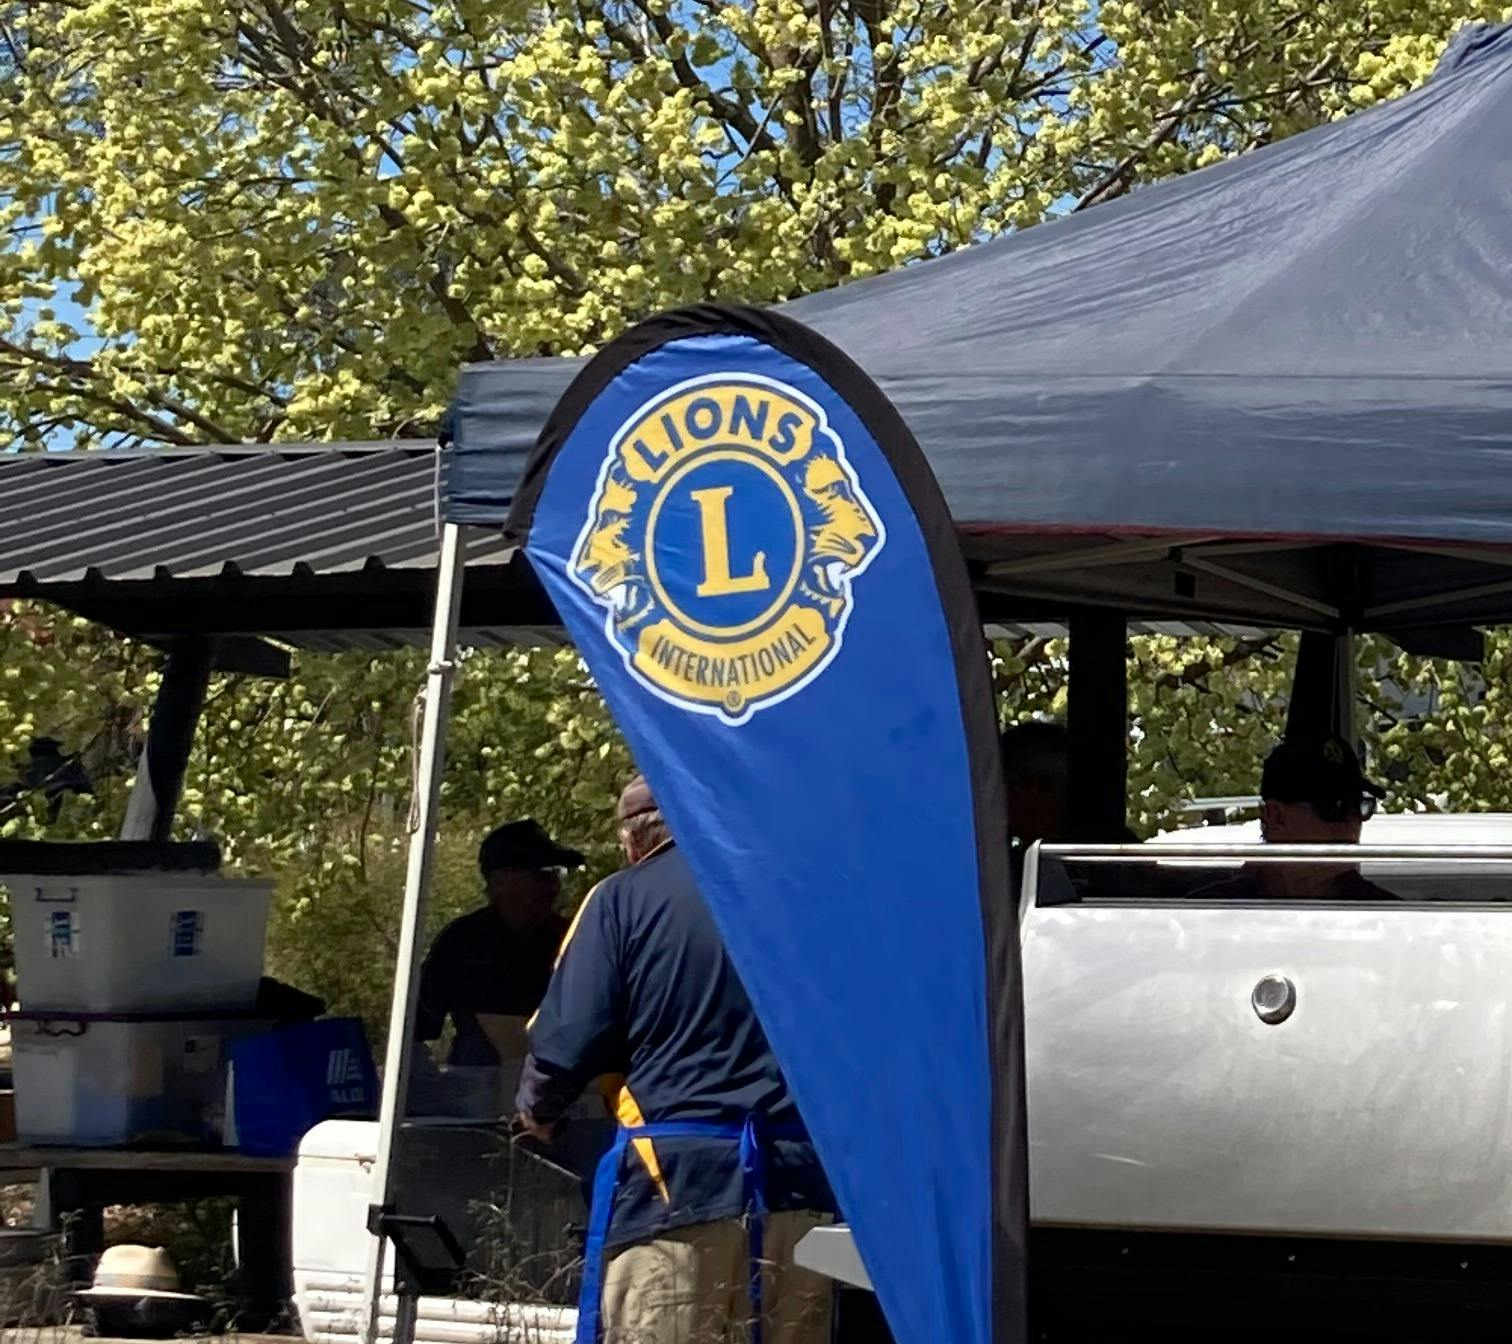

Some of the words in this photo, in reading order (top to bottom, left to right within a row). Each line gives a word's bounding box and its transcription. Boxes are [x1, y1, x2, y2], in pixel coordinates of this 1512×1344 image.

[633, 395, 803, 472] LIONS
[691, 488, 770, 597] L
[650, 623, 817, 687] INTERNATIONAL
